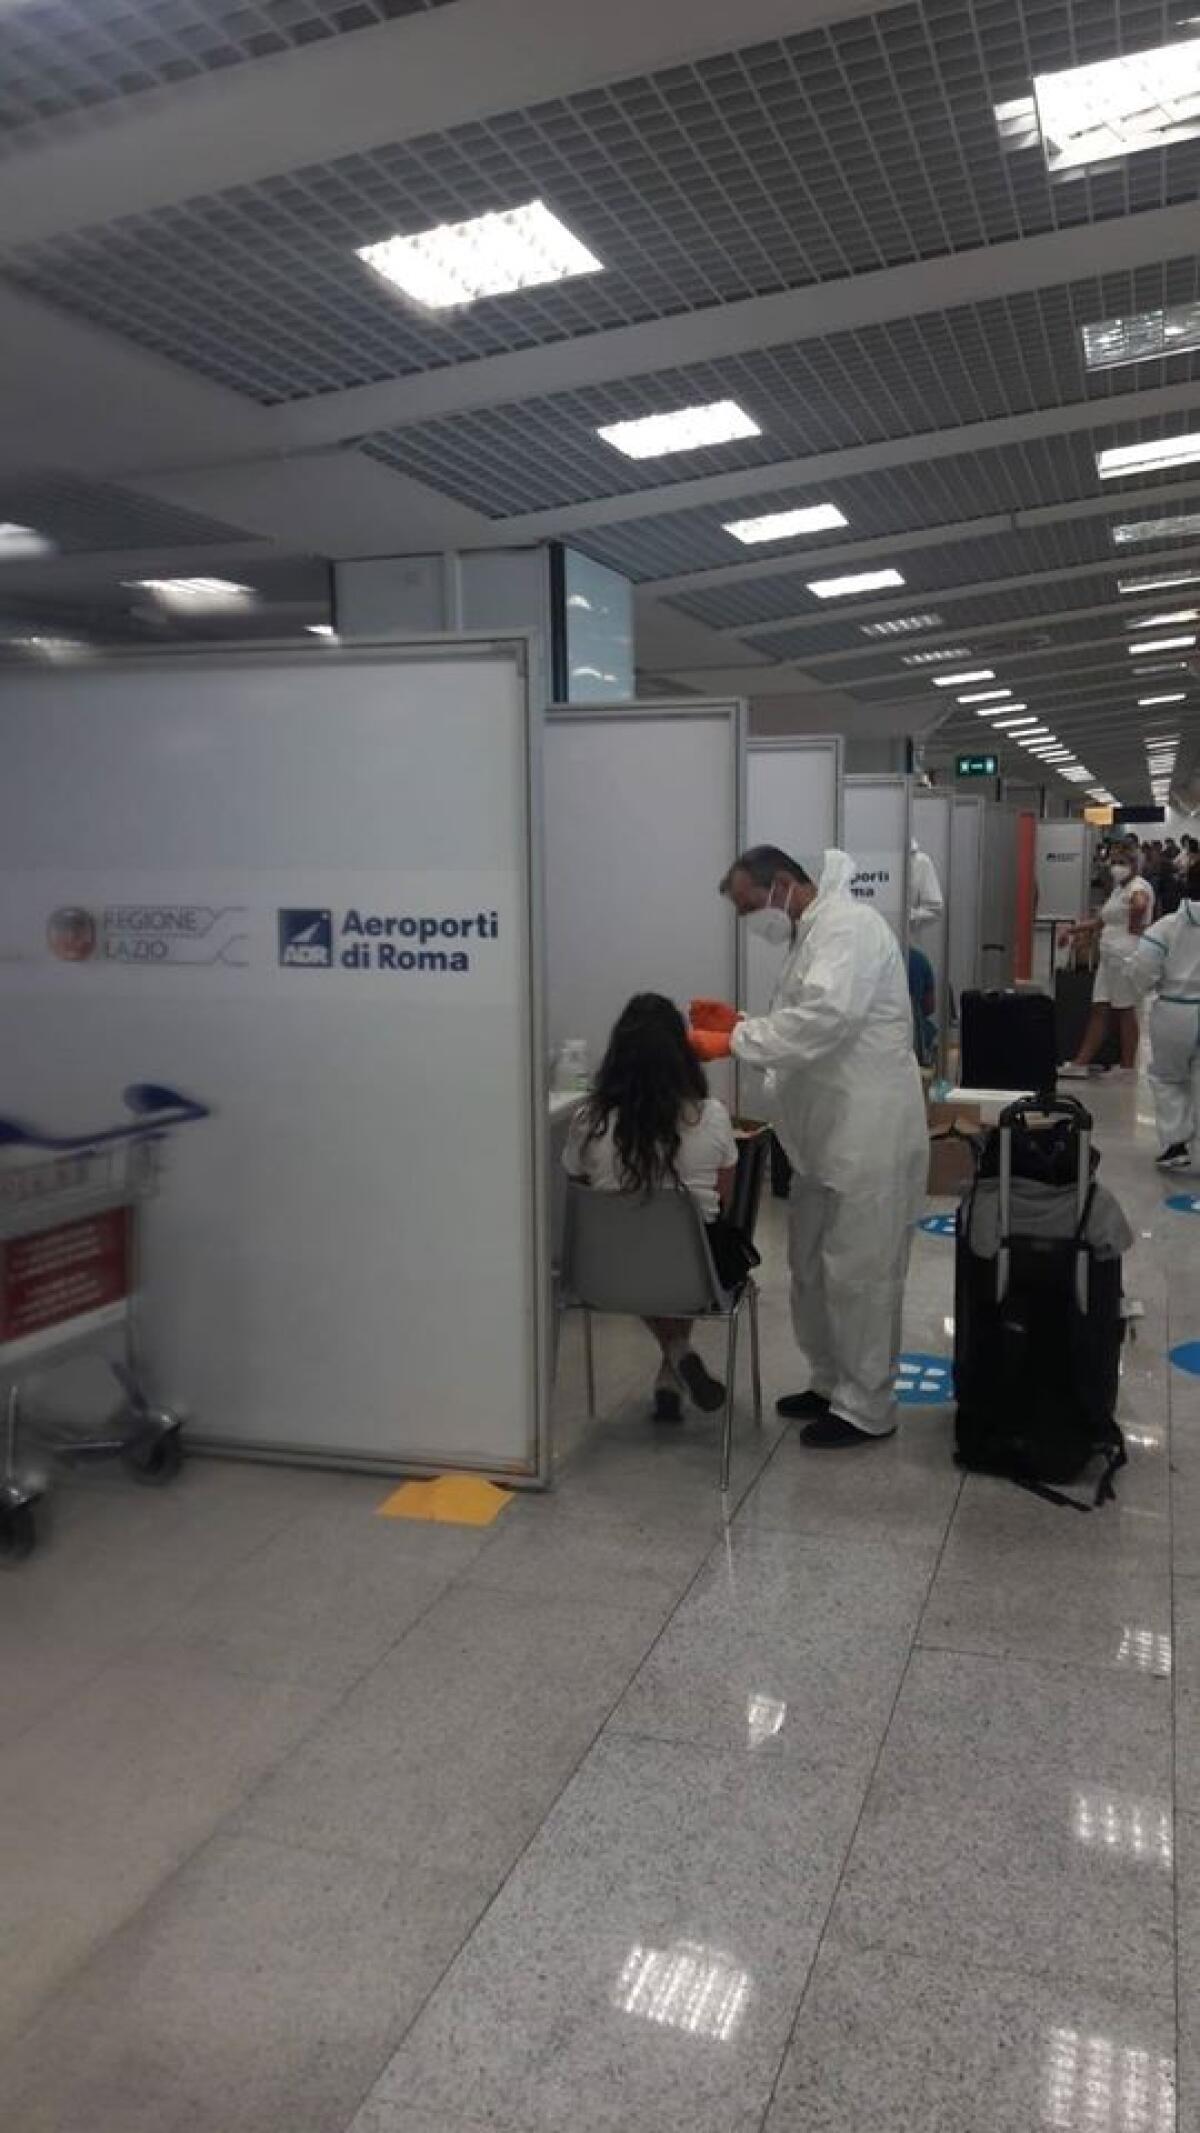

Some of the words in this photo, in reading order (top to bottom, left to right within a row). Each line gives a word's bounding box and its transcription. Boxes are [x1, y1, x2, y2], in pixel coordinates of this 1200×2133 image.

[103, 910, 197, 931] REGIONE
[342, 909, 498, 944] Aeroporti
[104, 940, 169, 960] LAZIO
[341, 943, 370, 970] di
[378, 943, 470, 971] Roma
